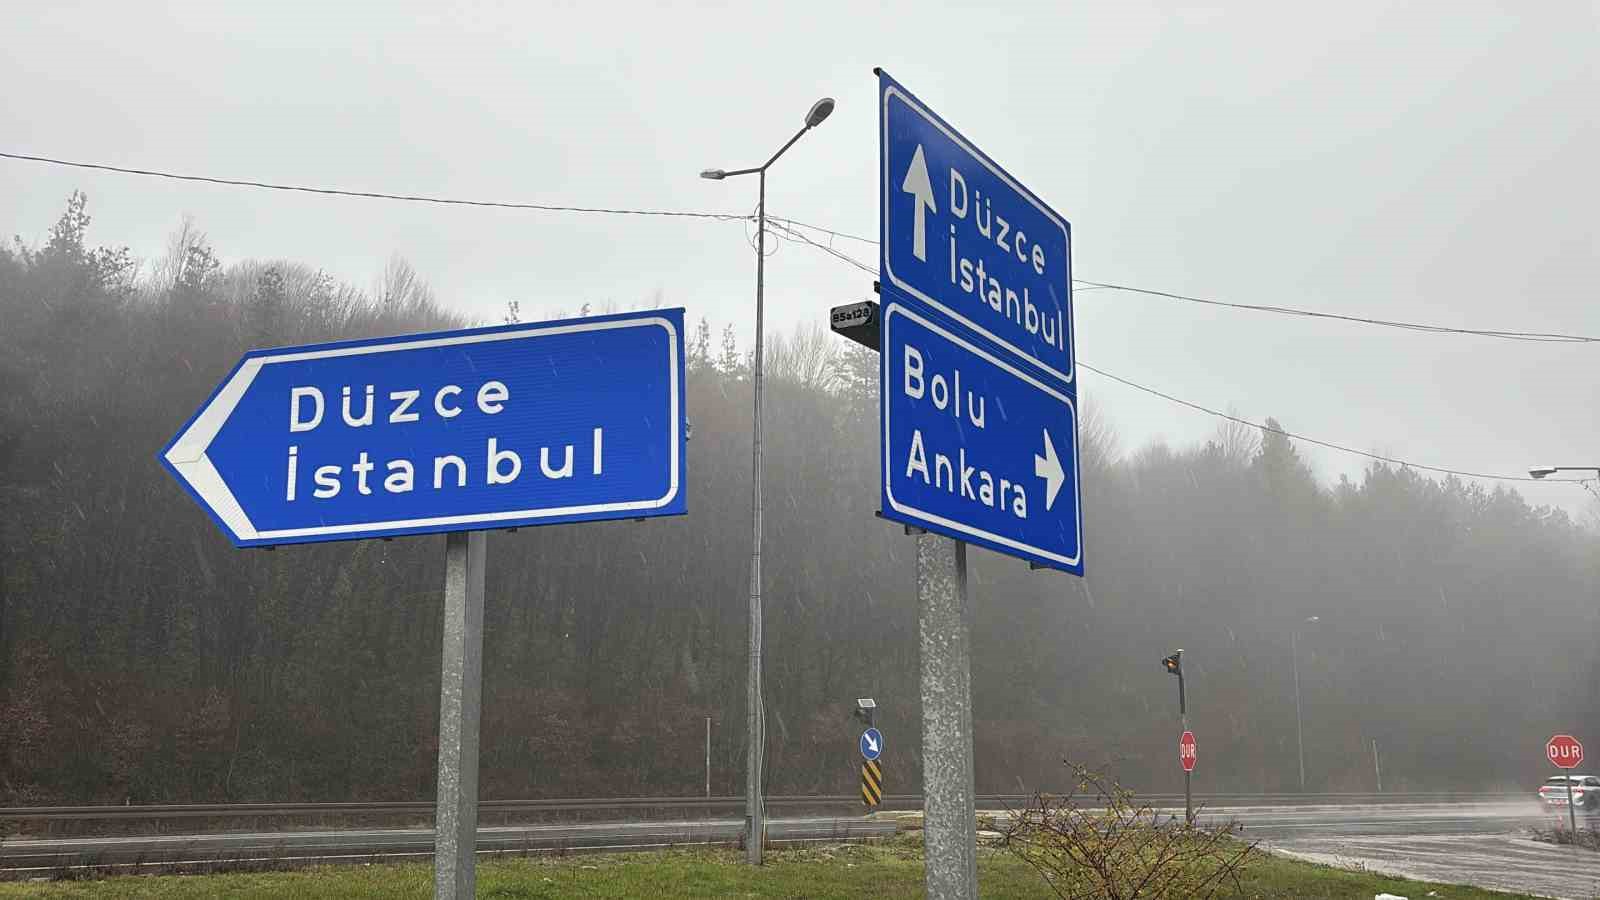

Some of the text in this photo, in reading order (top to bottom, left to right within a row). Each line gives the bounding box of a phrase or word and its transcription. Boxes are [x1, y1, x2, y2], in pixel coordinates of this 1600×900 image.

[950, 167, 1045, 275] Düzce
[950, 223, 1063, 351] İstanbul
[289, 381, 509, 433] Düzce
[904, 345, 985, 429] Bolu
[286, 427, 603, 501] İstanbul
[906, 430, 1027, 518] Ankara
[1181, 743, 1195, 759] DUR
[1549, 745, 1580, 758] DUR
